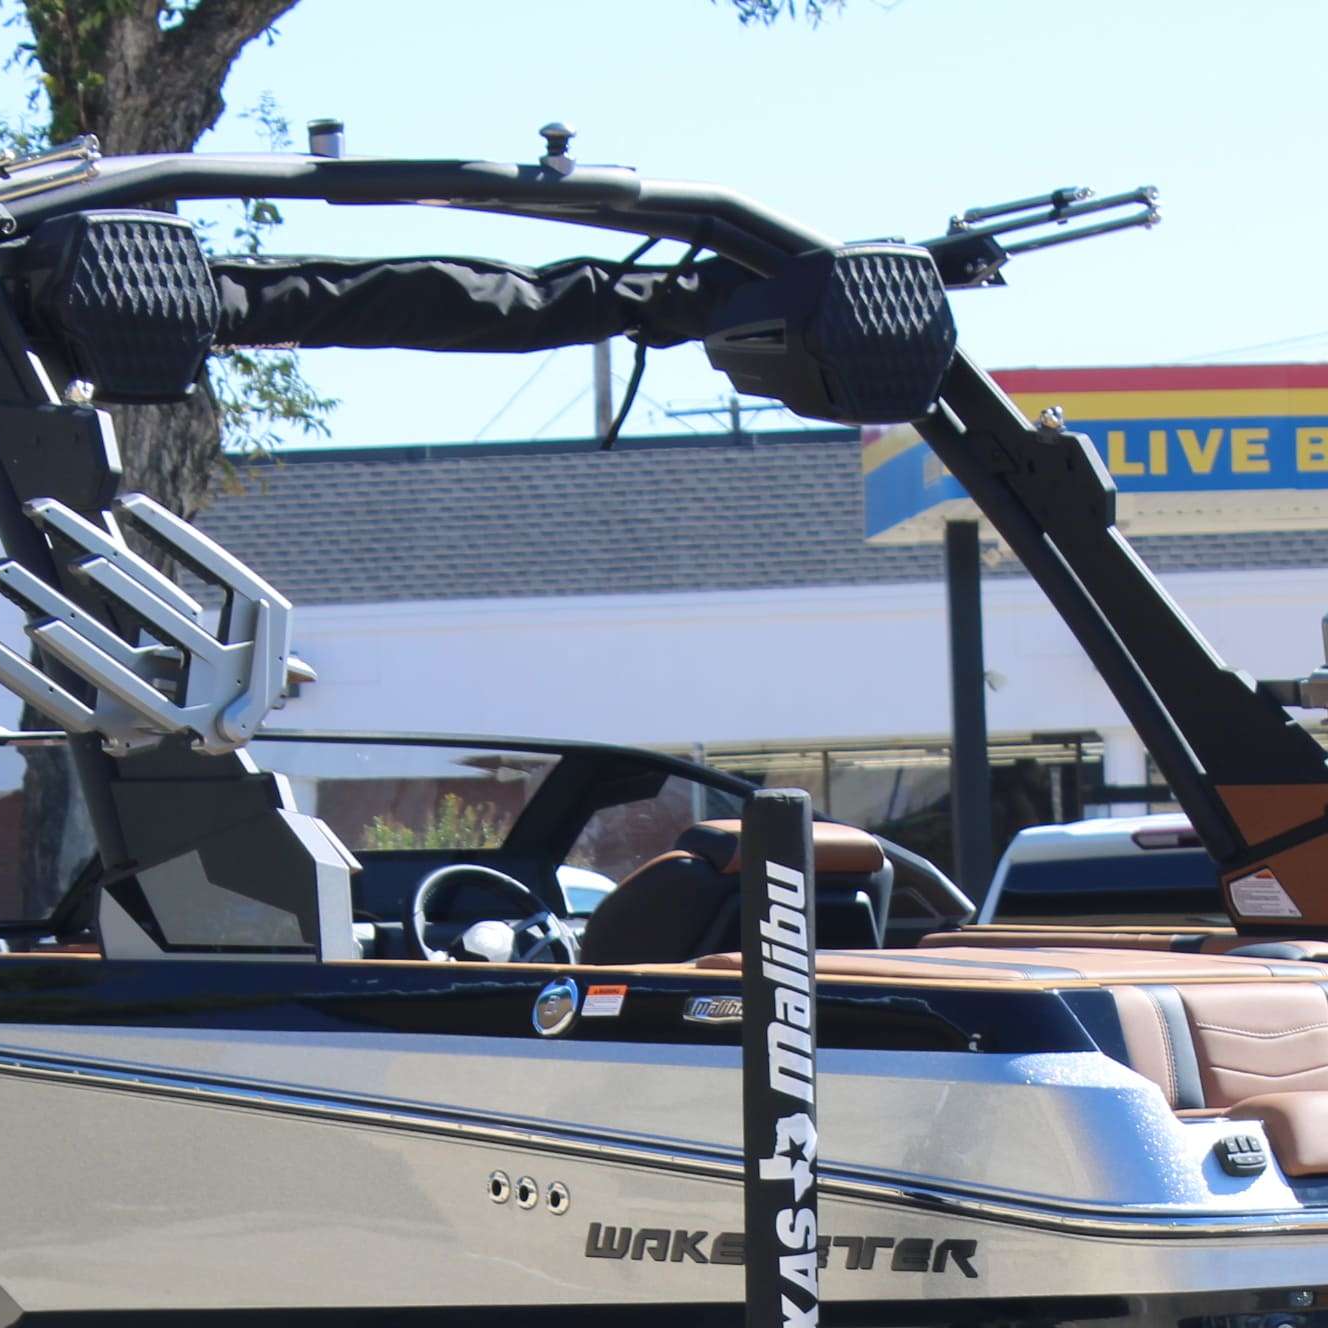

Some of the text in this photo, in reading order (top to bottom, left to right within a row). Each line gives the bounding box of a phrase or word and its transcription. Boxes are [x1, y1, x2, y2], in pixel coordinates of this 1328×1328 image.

[1107, 428, 1270, 477] LIVE
[759, 860, 814, 1104] Malibu
[585, 1222, 978, 1278] WAKETTER
